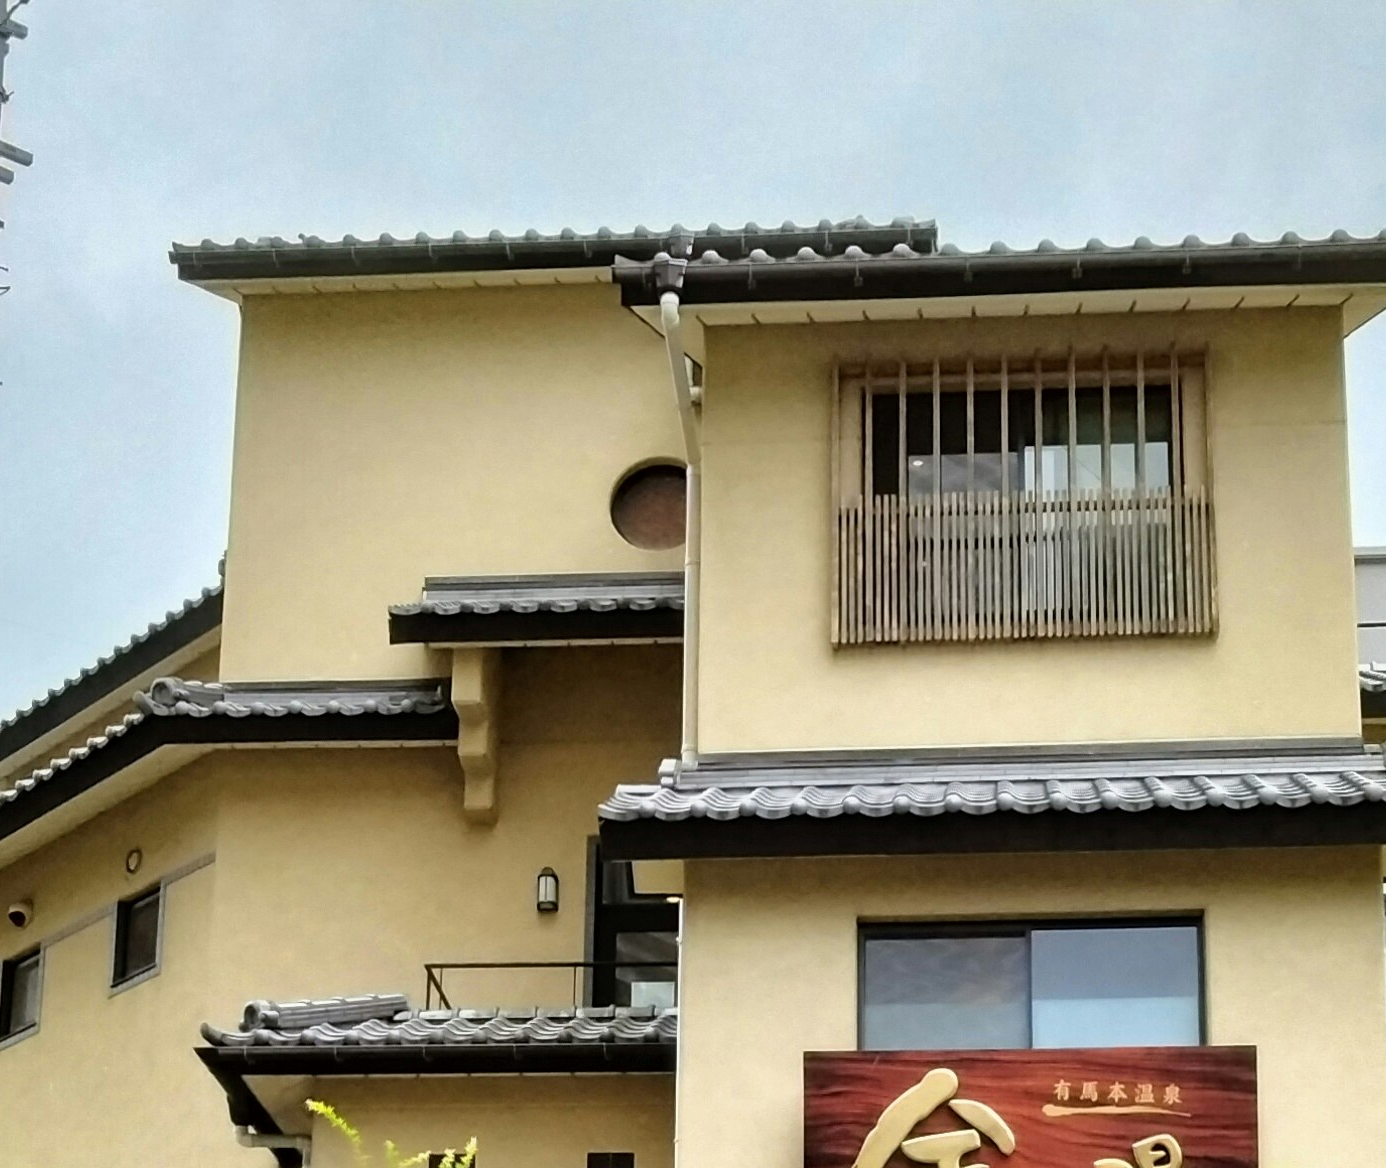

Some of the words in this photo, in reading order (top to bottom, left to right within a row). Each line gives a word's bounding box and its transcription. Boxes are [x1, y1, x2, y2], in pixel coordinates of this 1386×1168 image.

[1053, 1078, 1183, 1105] 有馬本温泉
